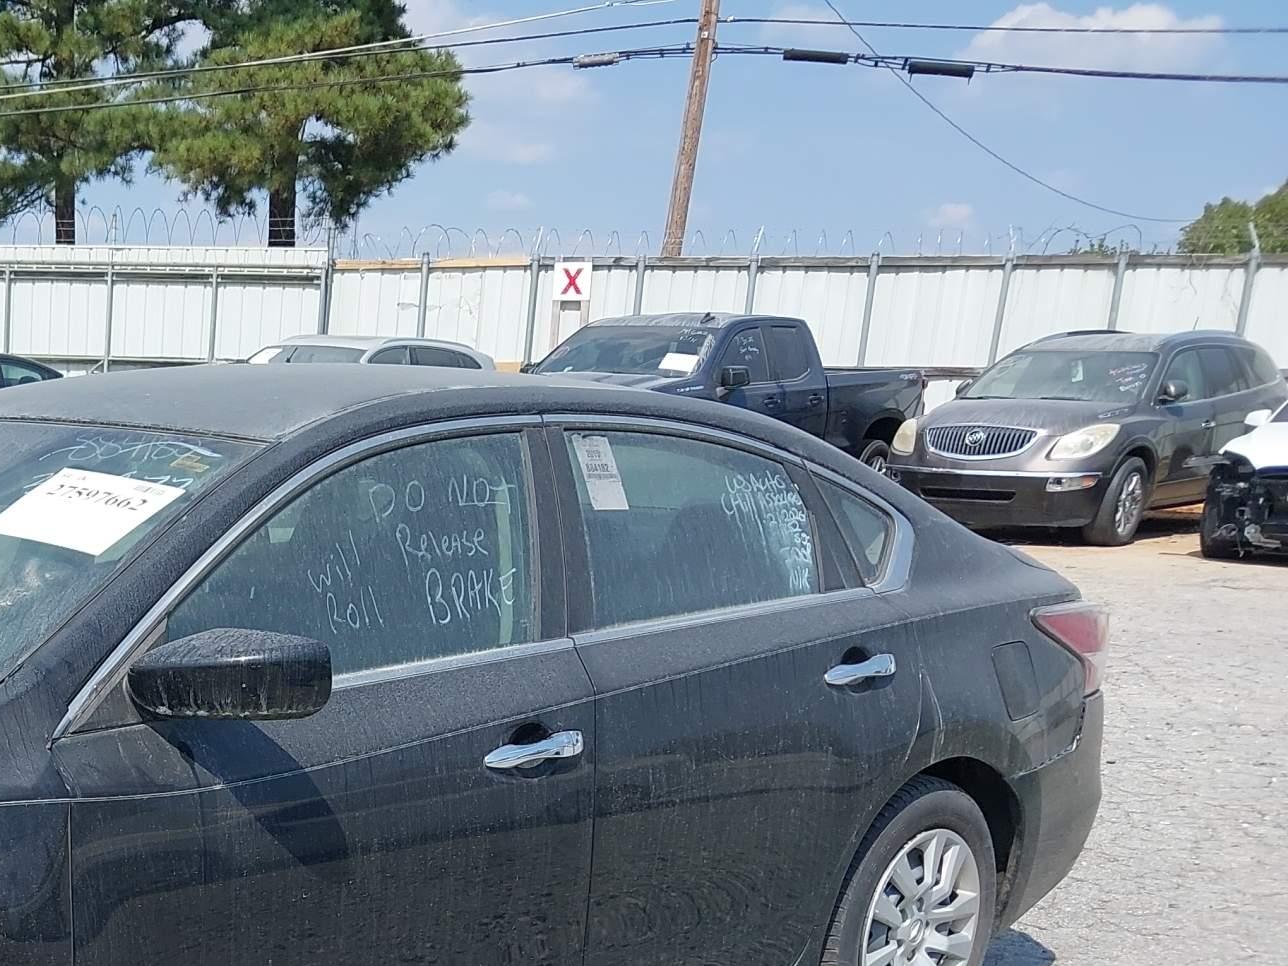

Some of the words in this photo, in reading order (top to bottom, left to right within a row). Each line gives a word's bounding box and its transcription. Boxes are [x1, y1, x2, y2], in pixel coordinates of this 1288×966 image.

[560, 267, 584, 295] X
[46, 484, 148, 511] 27597662
[368, 480, 424, 523] DO
[425, 567, 517, 625] BRAKE
